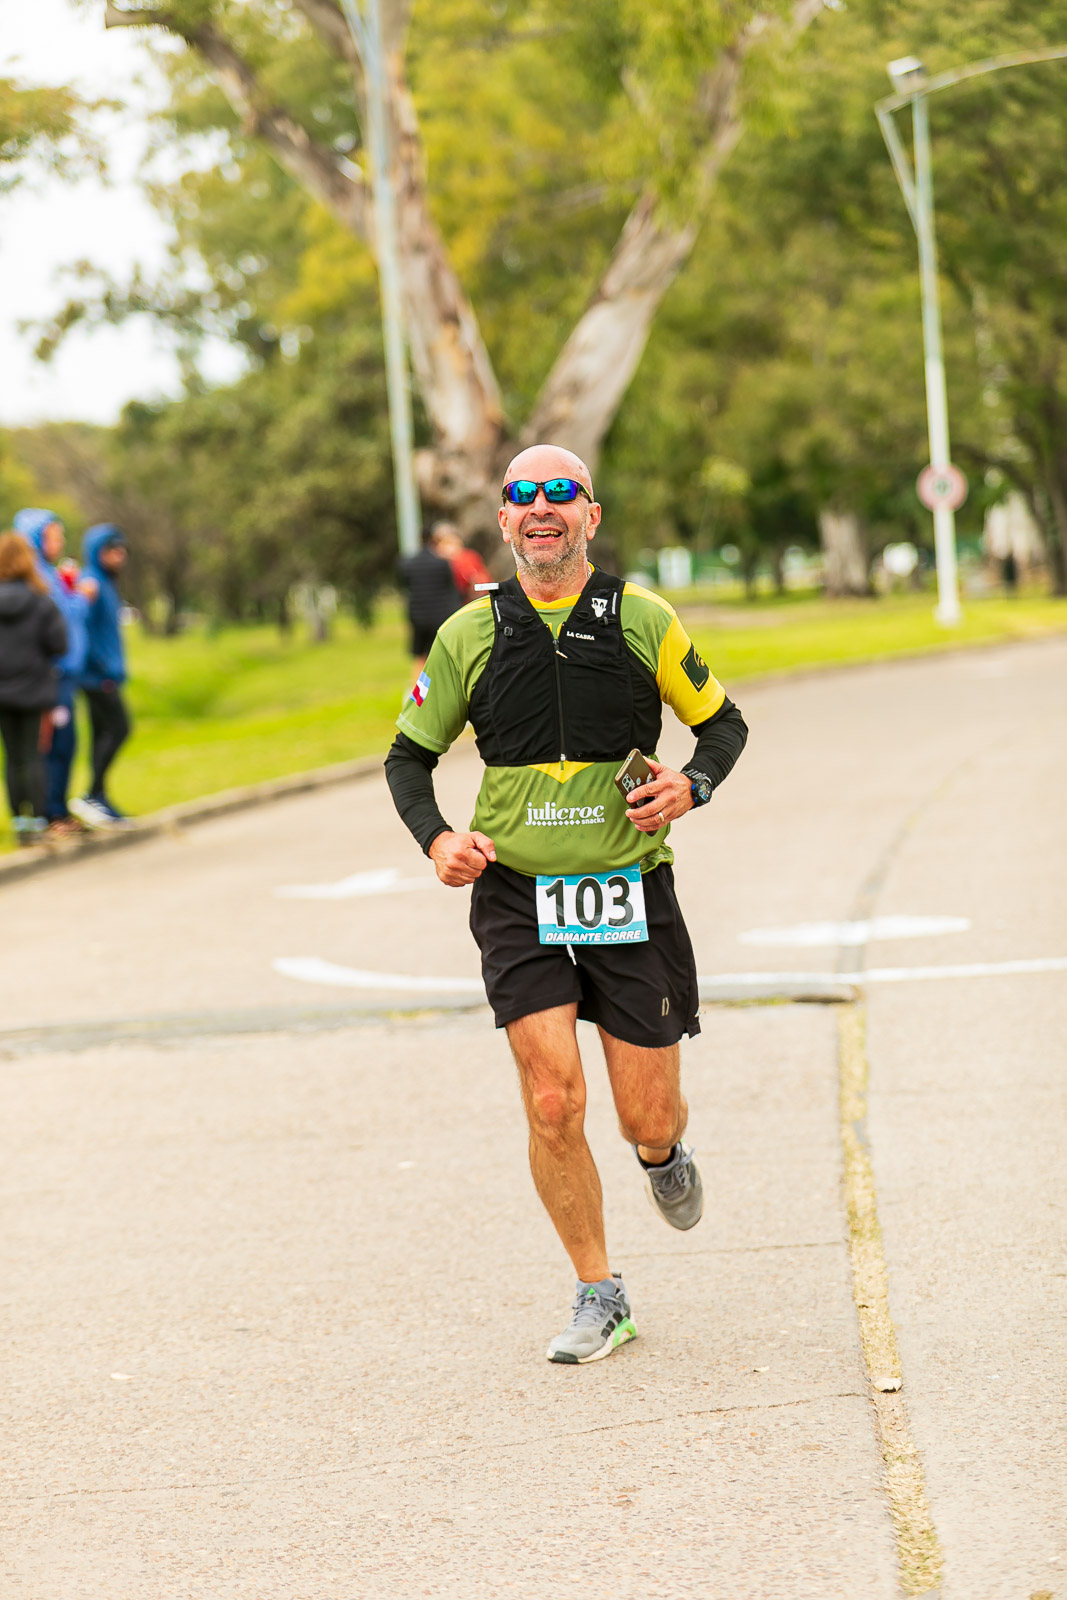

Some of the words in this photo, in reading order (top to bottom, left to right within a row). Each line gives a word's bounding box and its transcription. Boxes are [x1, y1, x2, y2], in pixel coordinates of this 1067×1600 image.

[575, 632, 595, 640] CABRA
[525, 802, 605, 825] julicroc
[581, 817, 605, 825] snacks
[545, 875, 634, 929] 103
[545, 932, 602, 942] DIAMANTE
[603, 930, 642, 941] CORRE
